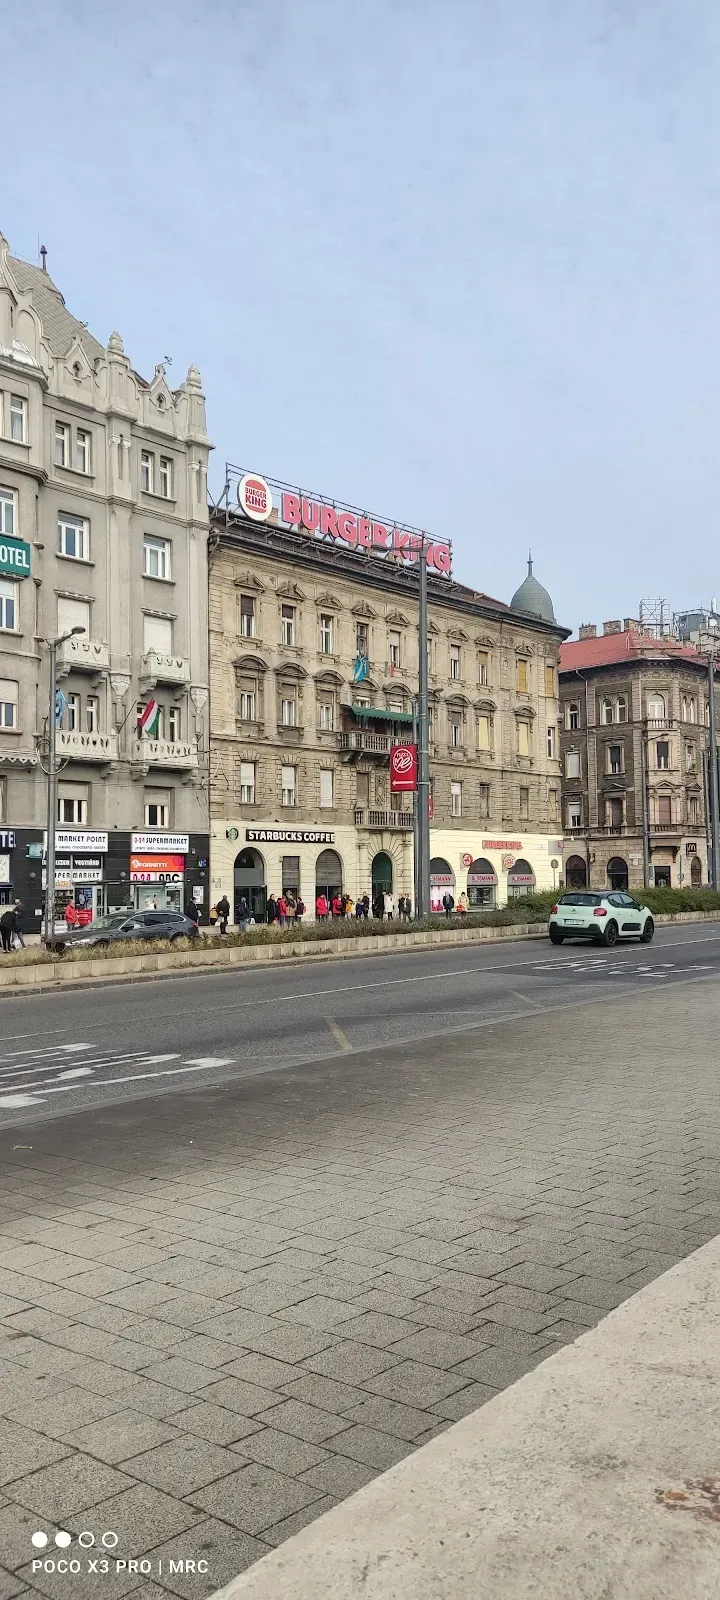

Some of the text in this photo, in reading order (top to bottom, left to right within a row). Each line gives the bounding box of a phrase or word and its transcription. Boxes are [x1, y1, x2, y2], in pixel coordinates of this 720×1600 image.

[245, 487, 267, 499] BURGER
[245, 494, 267, 508] KING
[281, 492, 388, 548] BURGER
[248, 830, 335, 842] STARBUCKS COFFEE
[159, 874, 180, 882] ABC
